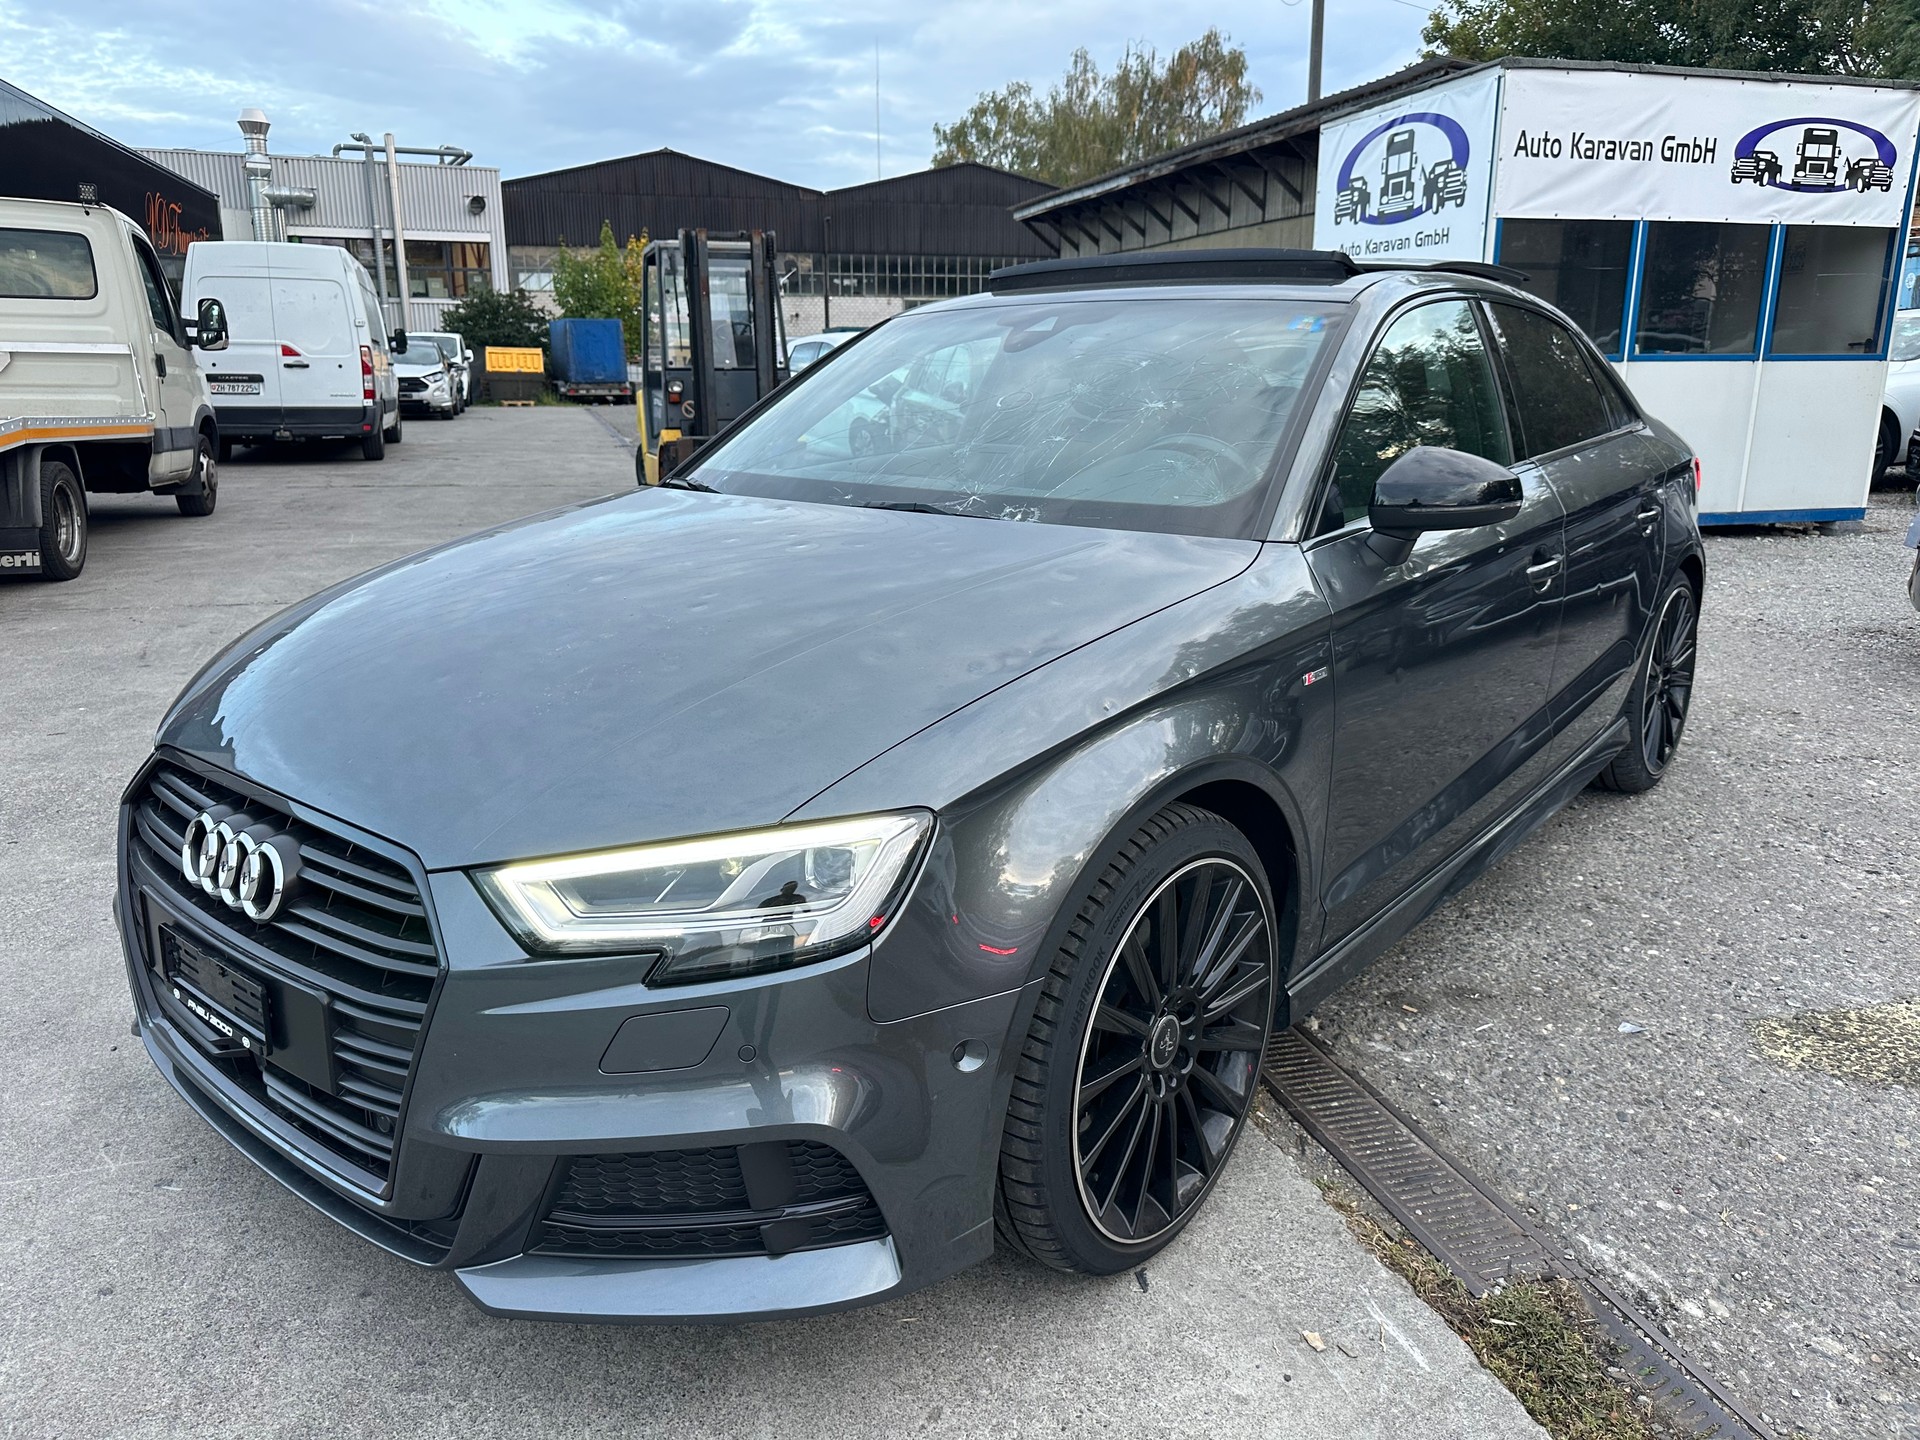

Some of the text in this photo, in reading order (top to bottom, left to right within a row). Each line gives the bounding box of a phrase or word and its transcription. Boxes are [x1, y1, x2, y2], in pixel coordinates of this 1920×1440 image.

[1514, 130, 1717, 164] Auto Karavan GmbH
[1364, 236, 1411, 255] Karavan
[1415, 227, 1450, 248] GmbH
[0, 552, 40, 567] erli
[209, 1014, 233, 1037] 2000
